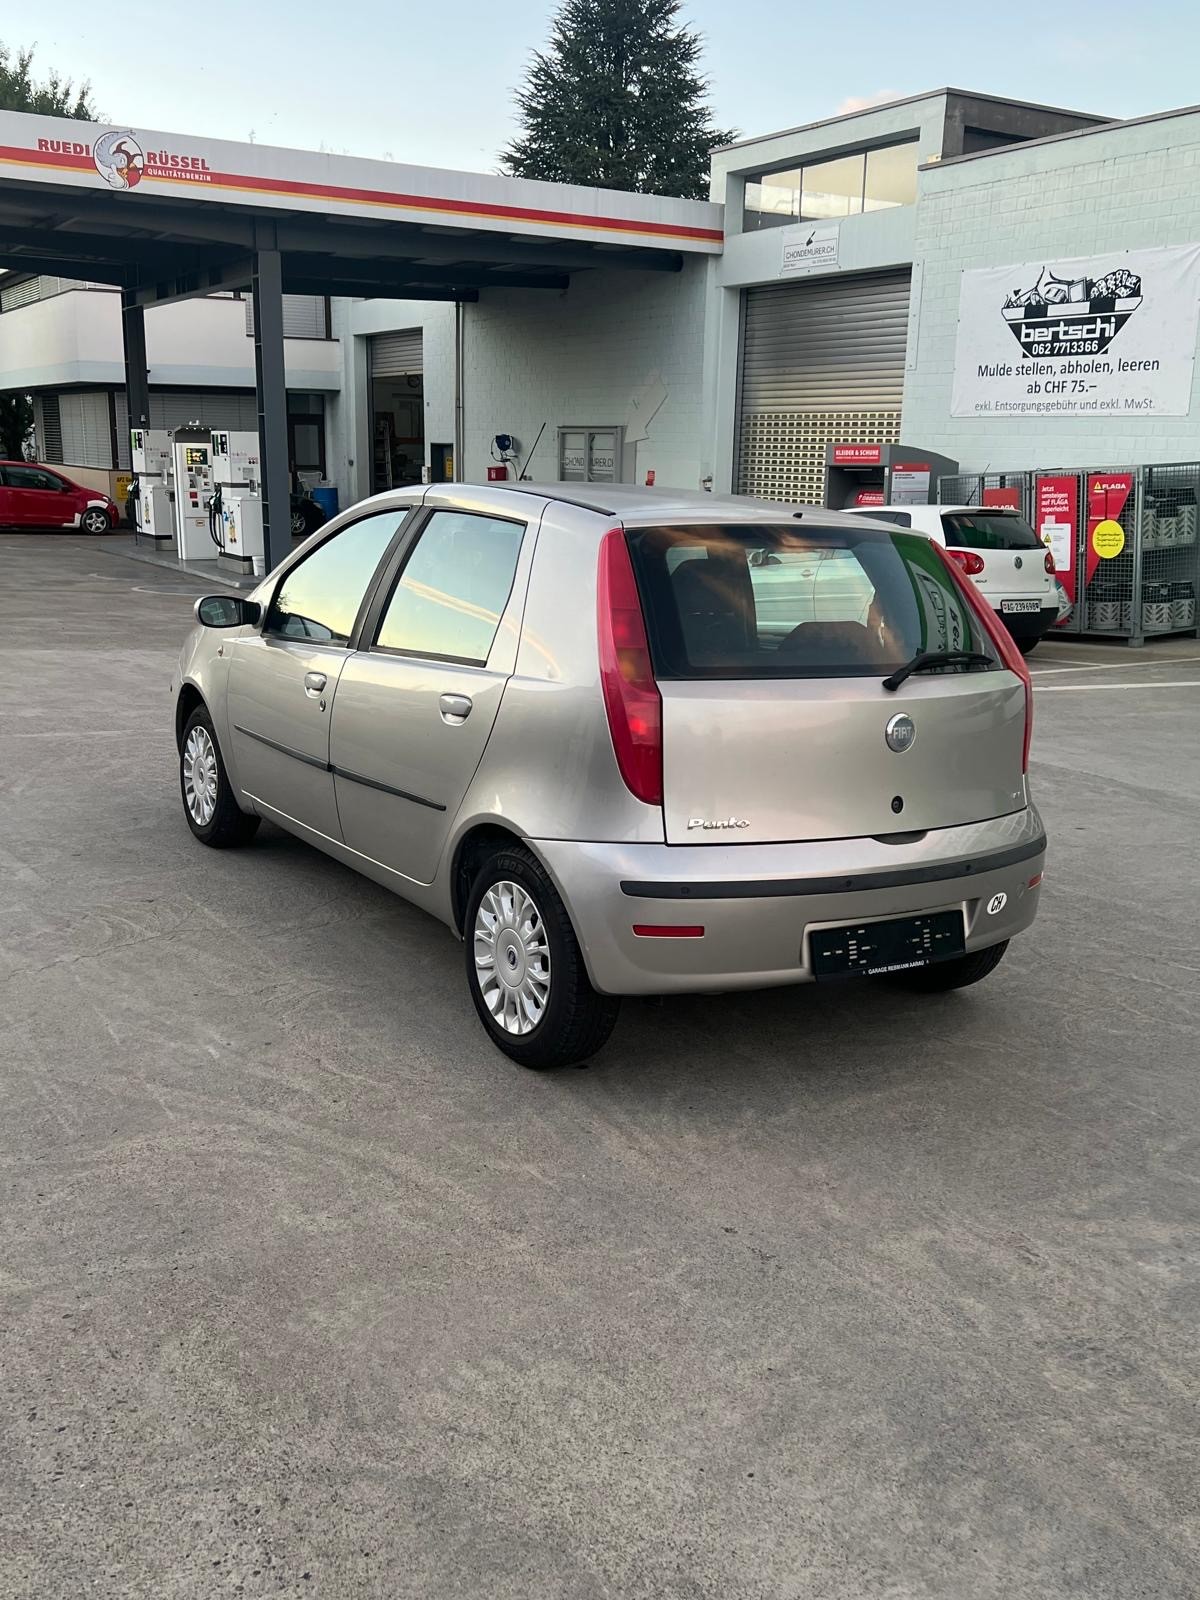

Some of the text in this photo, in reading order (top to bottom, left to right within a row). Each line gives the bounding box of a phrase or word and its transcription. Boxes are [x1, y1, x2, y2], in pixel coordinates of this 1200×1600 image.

[38, 138, 90, 156] RUEDI
[147, 150, 210, 171] RÜSSEL
[147, 167, 212, 182] QUALITÄTSBENZIN
[785, 245, 835, 260] CHONDEMURER.CH
[1020, 316, 1116, 343] bertschi
[1032, 340, 1099, 355] 062 7713366
[977, 358, 1160, 377] Mulde stellen, abholen, leeren
[1026, 382, 1041, 394] ab
[1044, 380, 1068, 394] CHF
[974, 398, 1156, 413] exkl. Entsorgungsgebühr und exkl. MwSt.
[1041, 485, 1055, 493] Jetzt
[1041, 492, 1069, 501] umsteigen
[1041, 506, 1070, 514] superleicht
[892, 726, 912, 740] FIAT
[687, 816, 751, 831] Punto
[990, 894, 1005, 912] CH
[868, 966, 888, 975] GARAGE
